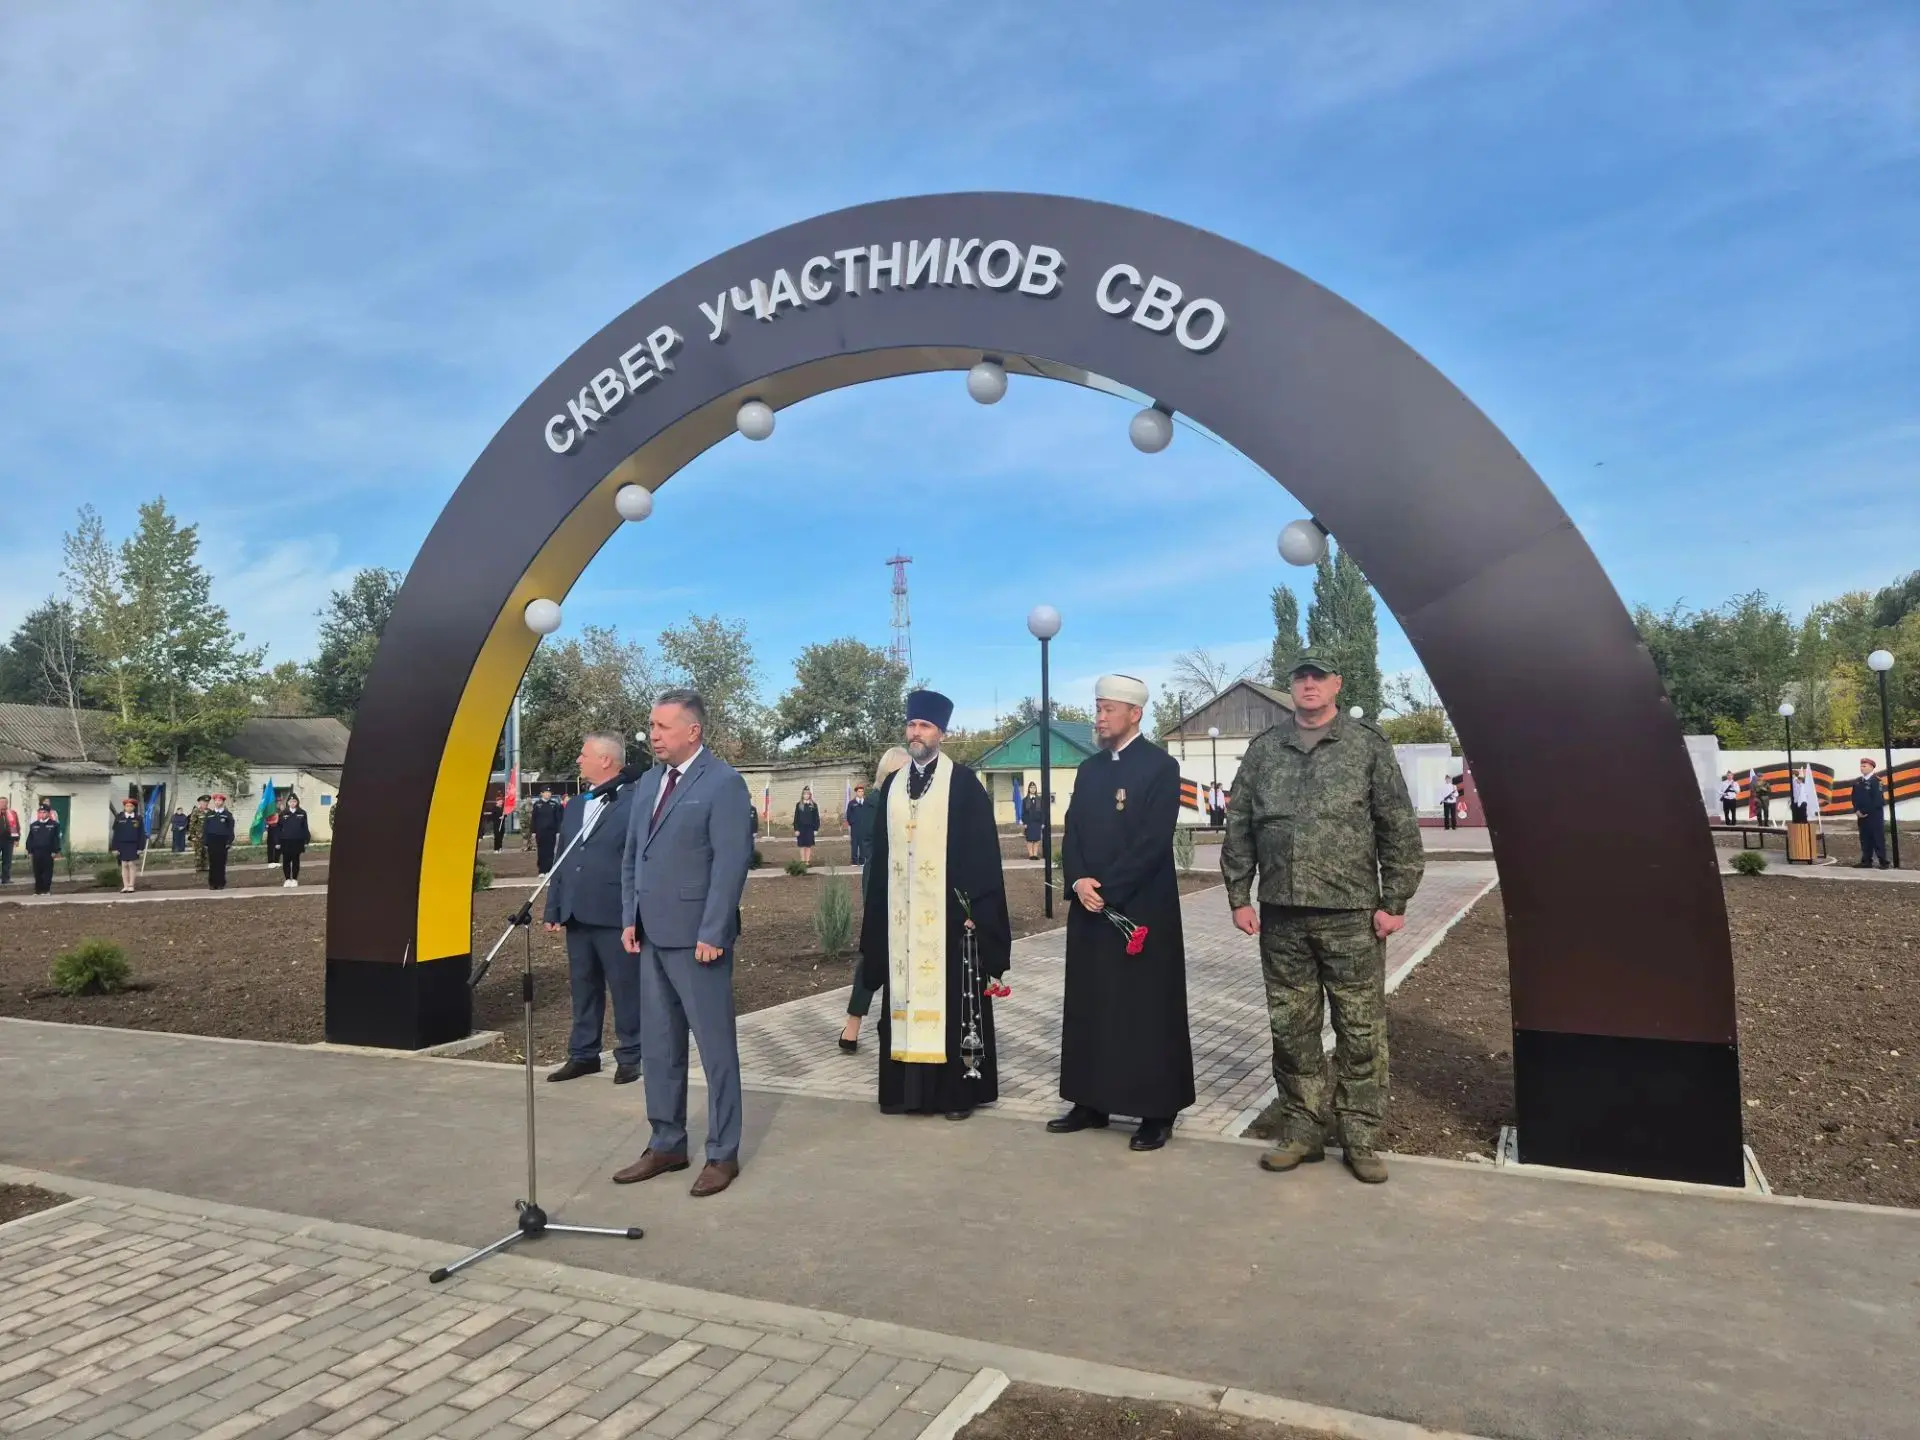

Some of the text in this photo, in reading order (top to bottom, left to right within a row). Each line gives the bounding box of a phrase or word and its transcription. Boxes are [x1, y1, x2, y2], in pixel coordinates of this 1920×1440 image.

[543, 237, 1227, 454] СКВЕР УЧАСТНИКОВ СВО
